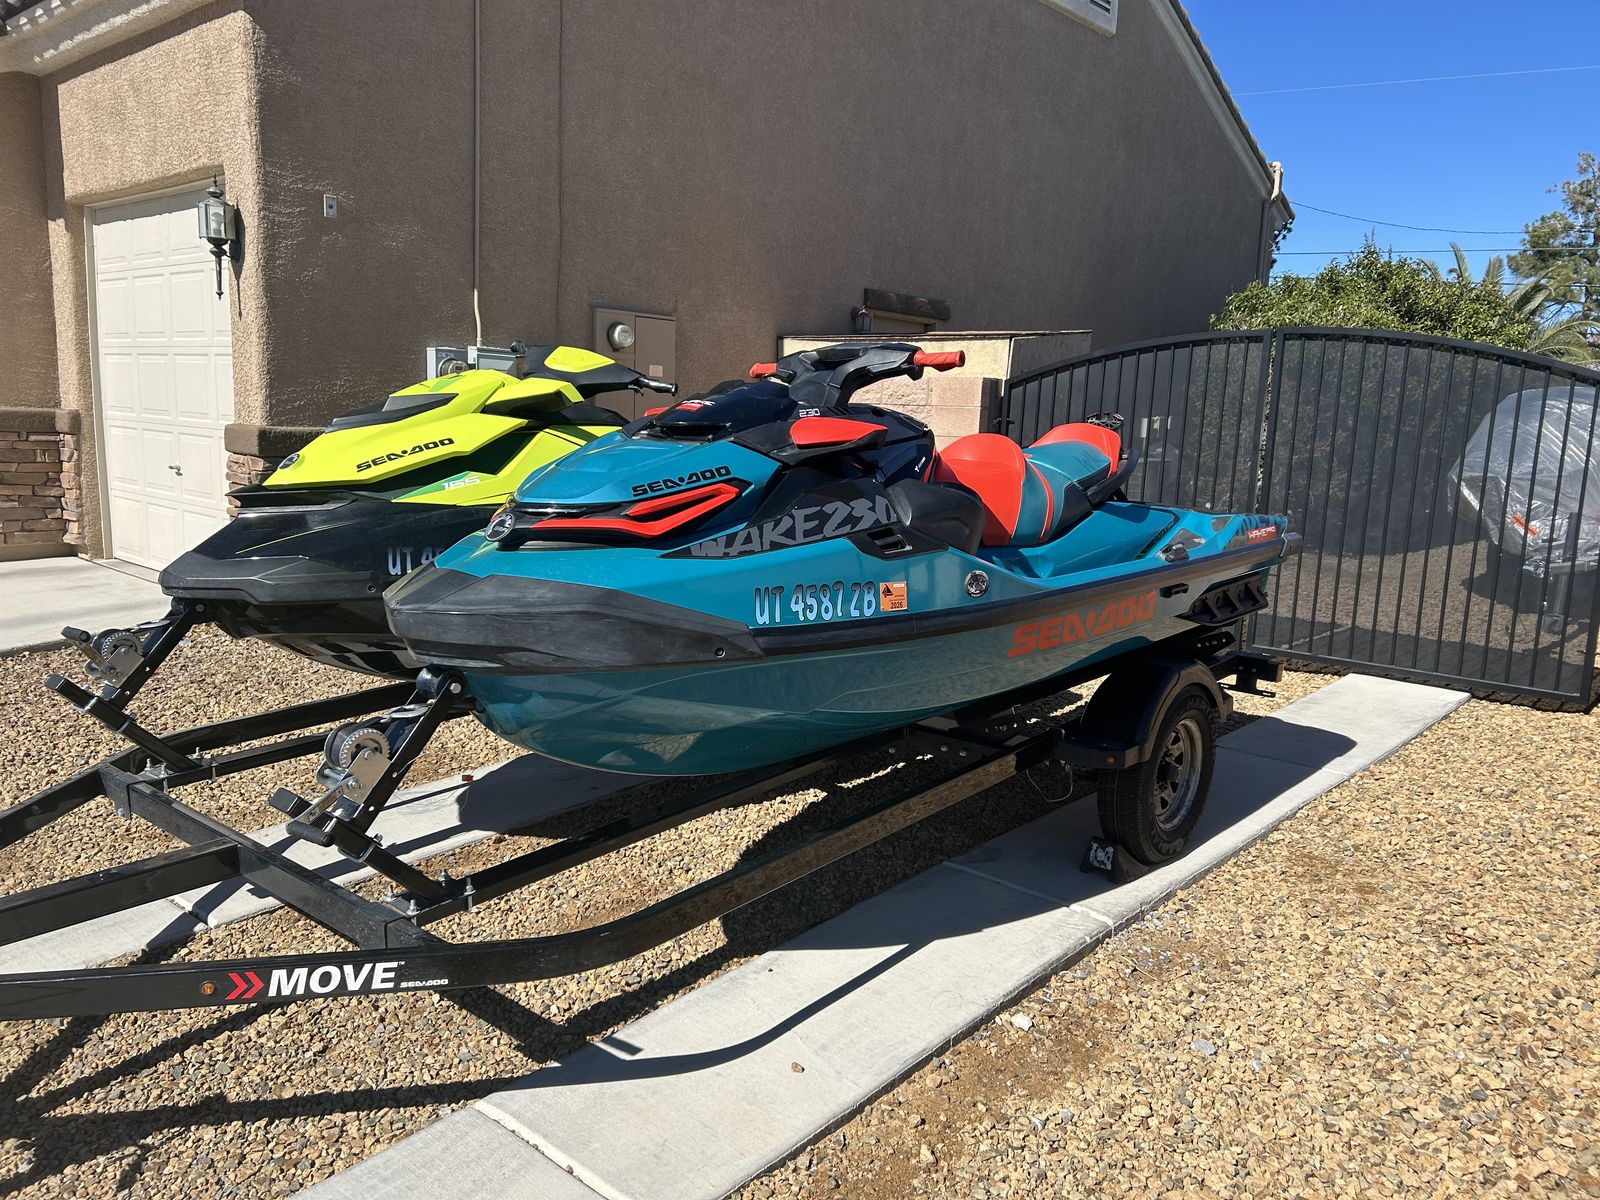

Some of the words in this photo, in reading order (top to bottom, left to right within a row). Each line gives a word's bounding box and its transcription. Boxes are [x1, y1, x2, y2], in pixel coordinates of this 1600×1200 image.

[798, 407, 821, 418] 230
[441, 475, 481, 491] 155
[387, 545, 414, 576] UT
[754, 585, 785, 625] UT
[790, 580, 845, 622] 4587
[849, 580, 877, 618] ZB
[890, 601, 903, 610] 2026
